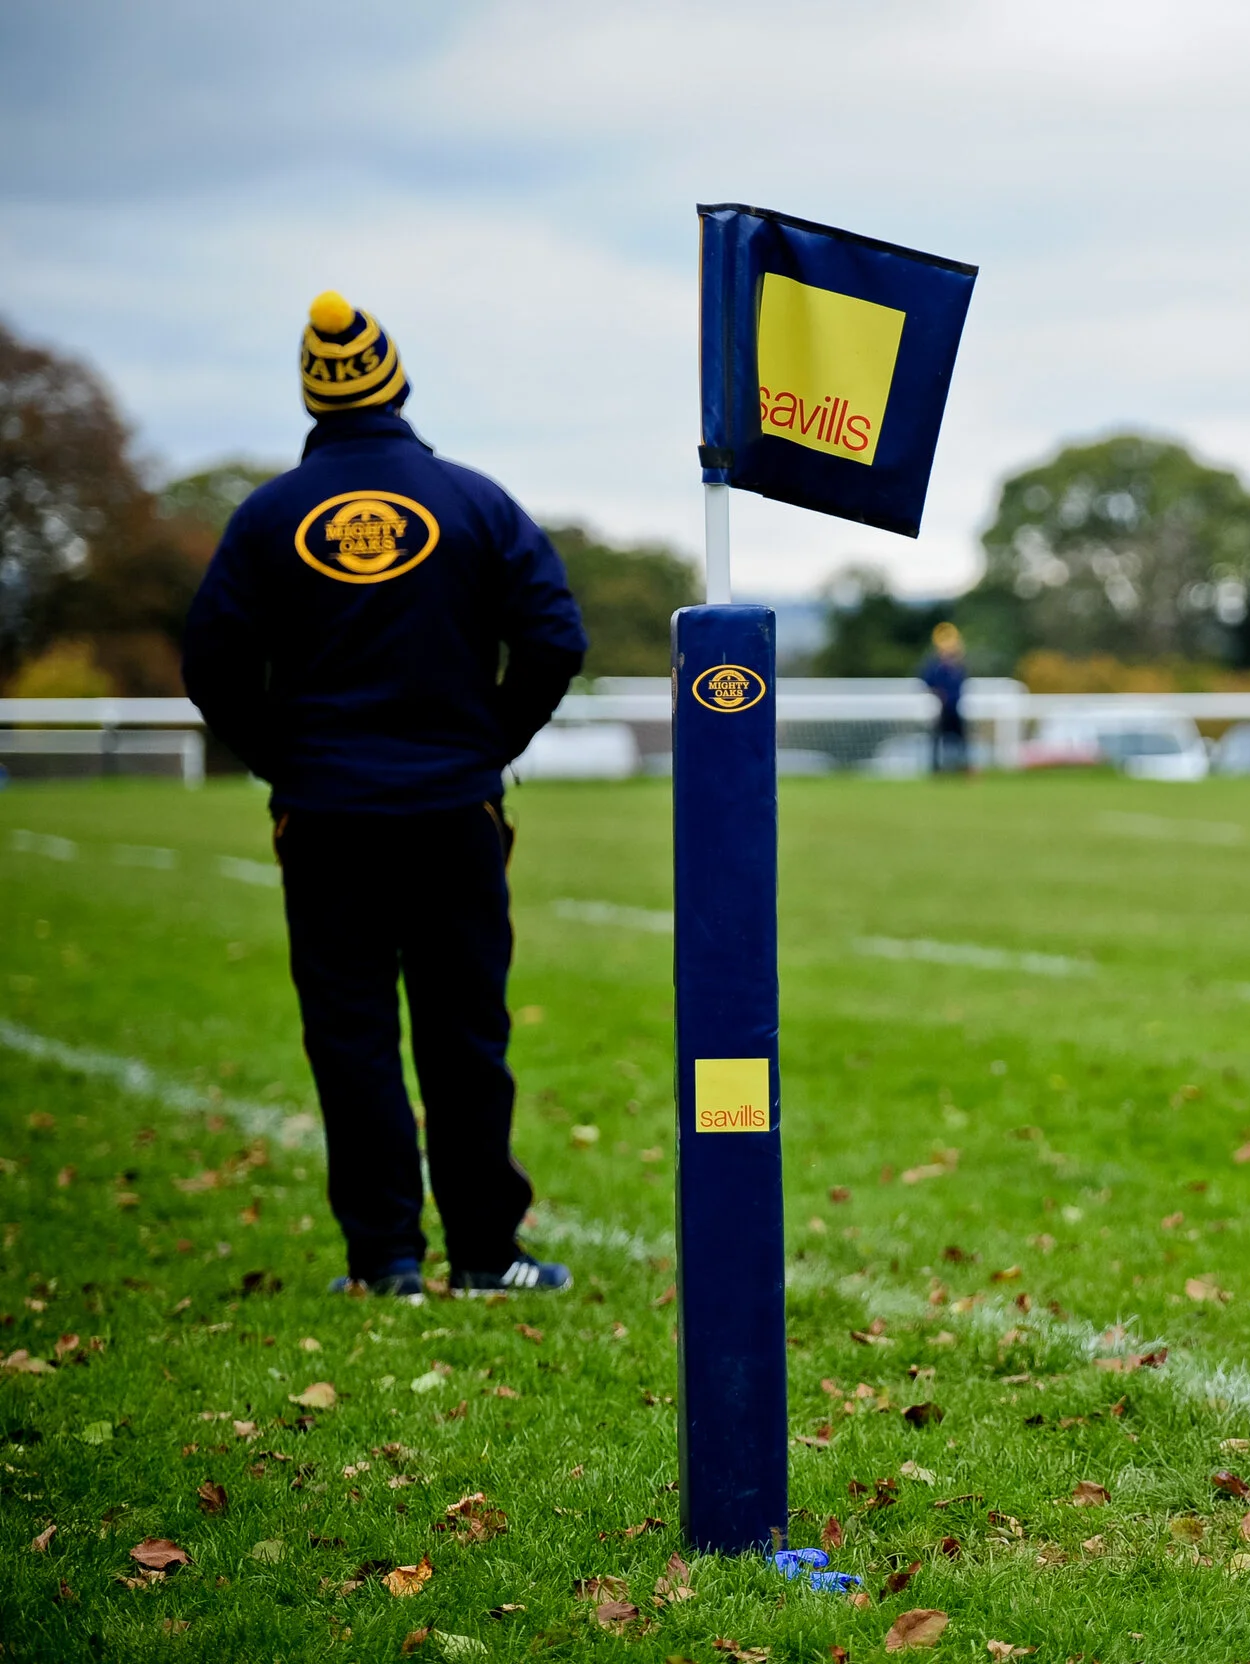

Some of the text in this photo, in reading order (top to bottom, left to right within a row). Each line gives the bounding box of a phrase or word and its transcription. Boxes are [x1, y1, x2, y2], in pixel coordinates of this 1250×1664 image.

[325, 520, 408, 541] MIGHTY
[339, 535, 396, 553] OAKS
[708, 681, 750, 690] MIGHTY
[715, 689, 744, 697] OAKS
[700, 1105, 766, 1128] savills
